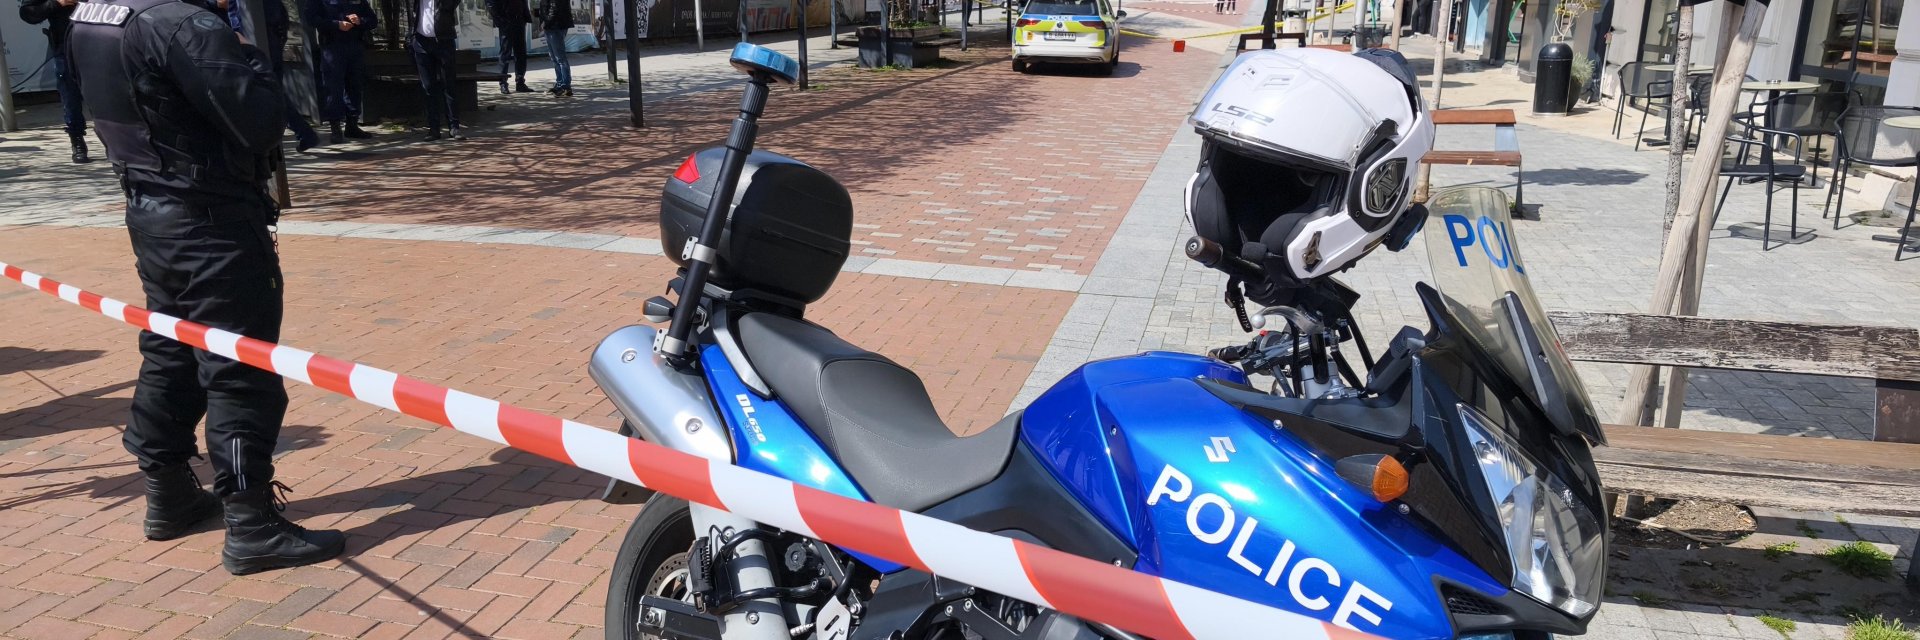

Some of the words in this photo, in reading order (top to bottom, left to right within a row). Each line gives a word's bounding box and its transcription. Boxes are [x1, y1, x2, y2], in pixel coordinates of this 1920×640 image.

[71, 2, 130, 25] POLICE
[1211, 102, 1275, 127] LS2
[1146, 463, 1394, 633] POLICE
